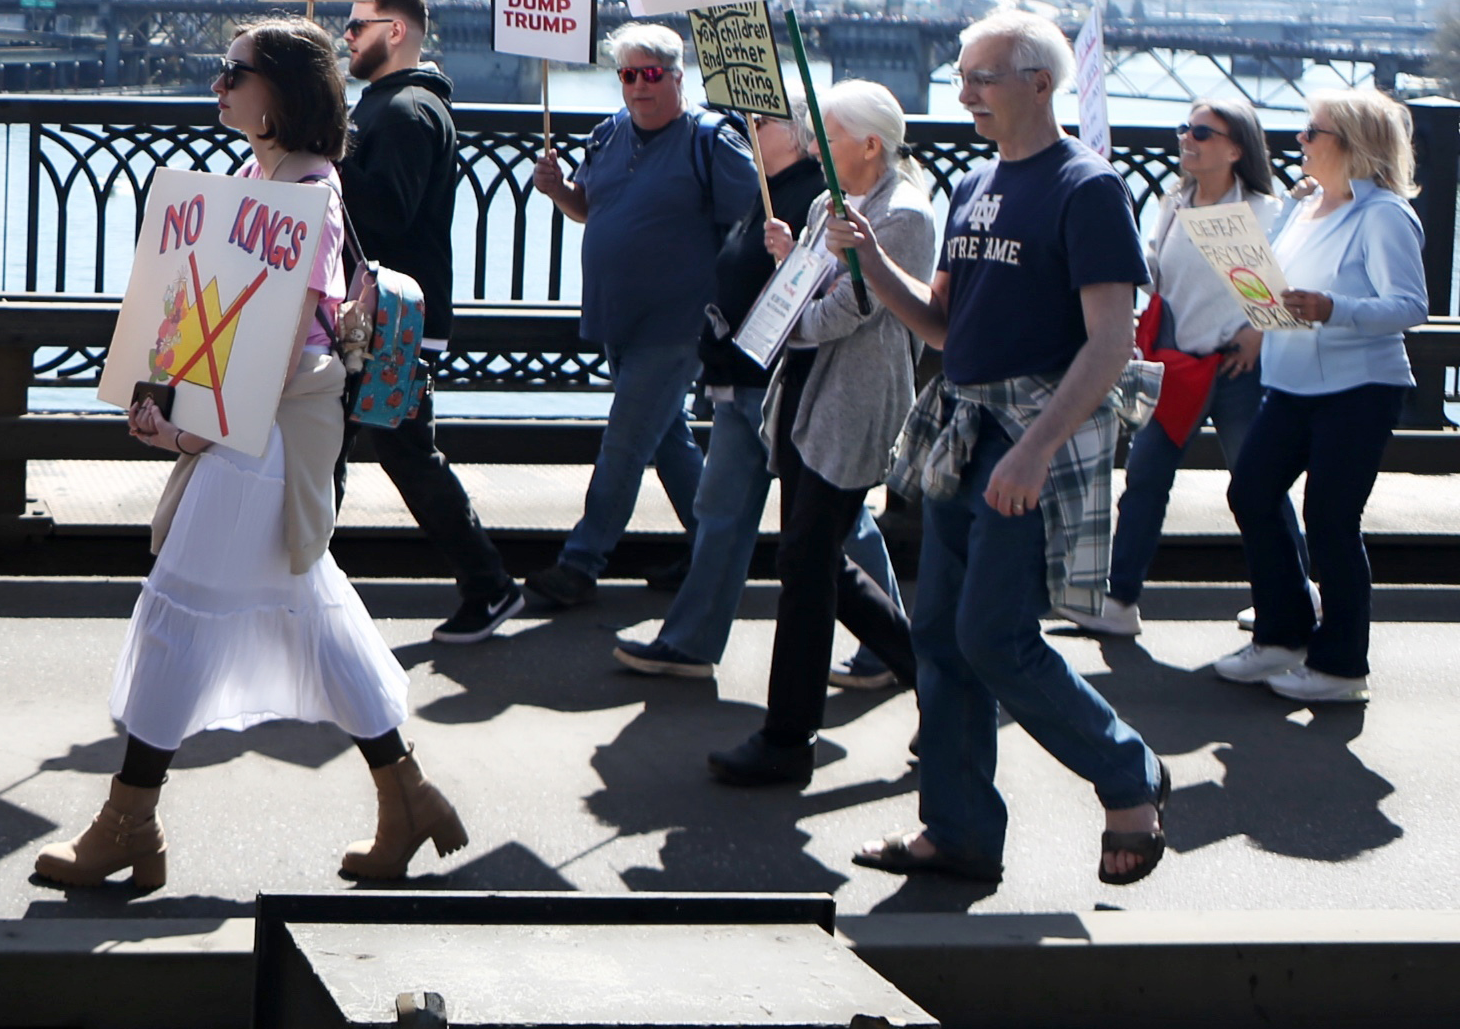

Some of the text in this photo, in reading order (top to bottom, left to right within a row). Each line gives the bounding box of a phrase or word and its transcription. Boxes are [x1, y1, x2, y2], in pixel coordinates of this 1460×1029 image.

[503, 10, 577, 35] TRUMP
[720, 18, 768, 40] children
[702, 42, 766, 70] and other
[732, 68, 774, 98] living
[733, 86, 781, 110] things
[159, 194, 308, 272] NO KINGS
[1188, 214, 1249, 238] DEFEAT
[983, 237, 1021, 266] AME
[1201, 244, 1273, 269] FASCISM
[1243, 303, 1271, 328] NO
